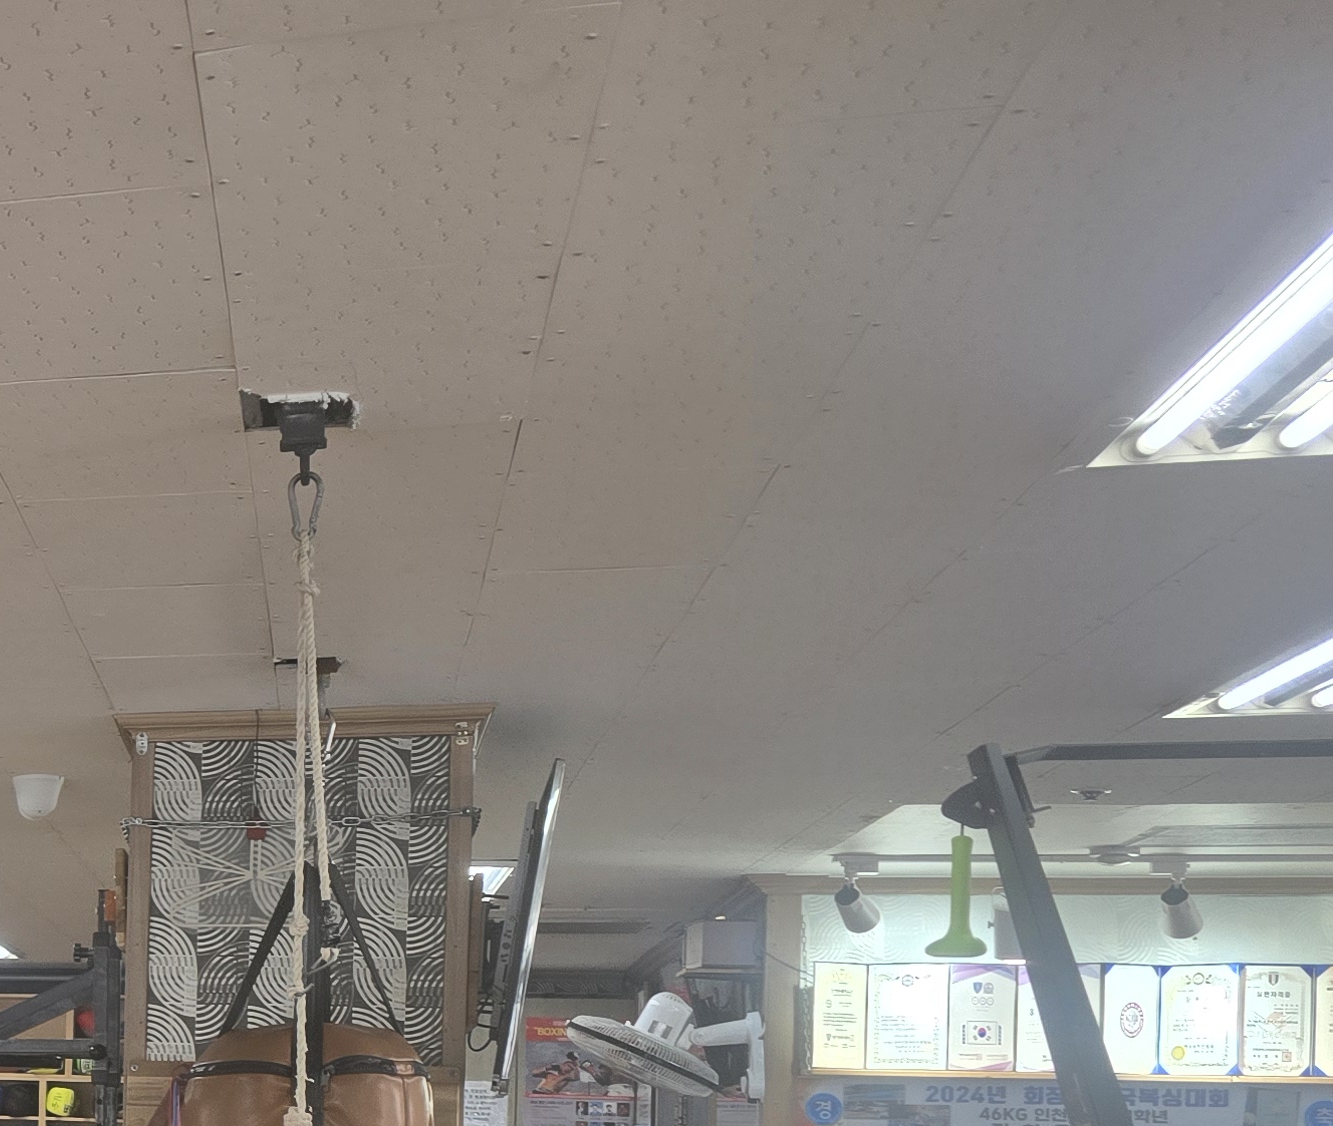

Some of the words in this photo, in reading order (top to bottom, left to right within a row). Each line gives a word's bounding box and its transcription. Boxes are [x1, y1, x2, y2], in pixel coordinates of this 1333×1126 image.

[536, 1026, 567, 1037] BOXIN
[925, 1085, 1007, 1104] 2024년
[815, 1100, 833, 1120] 경
[978, 1107, 1028, 1122] 46KG
[1130, 1109, 1169, 1124] 학년
